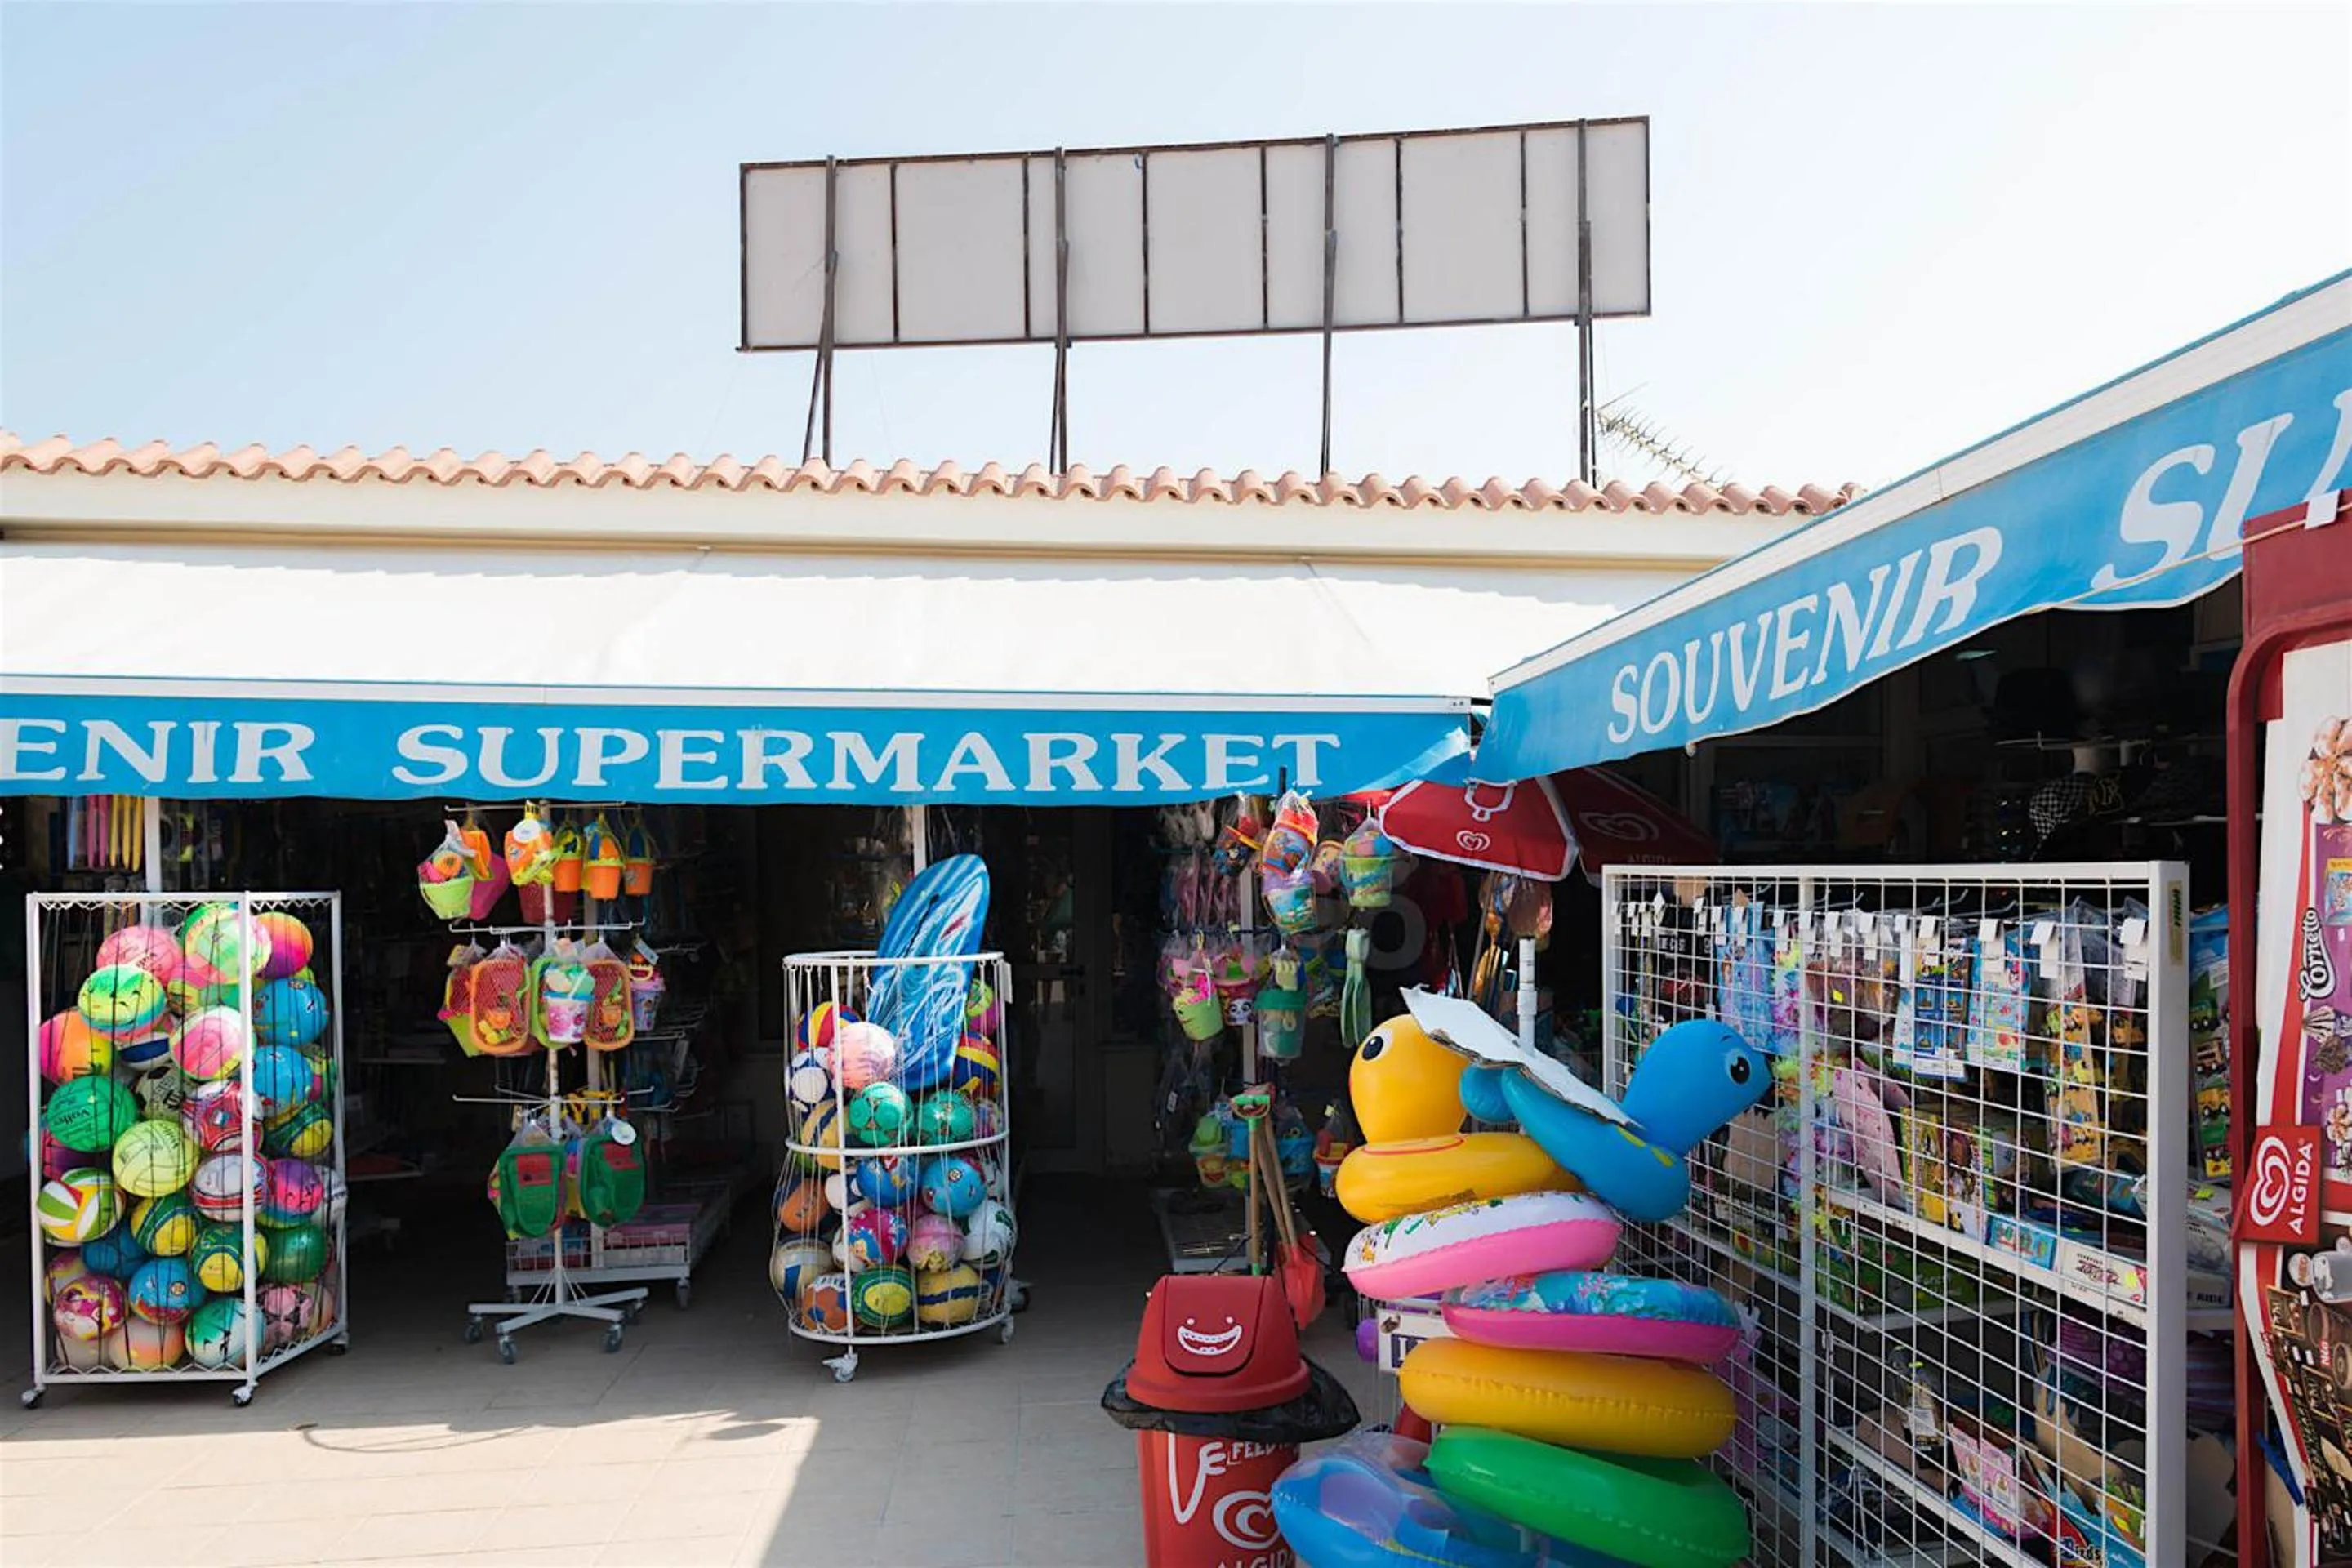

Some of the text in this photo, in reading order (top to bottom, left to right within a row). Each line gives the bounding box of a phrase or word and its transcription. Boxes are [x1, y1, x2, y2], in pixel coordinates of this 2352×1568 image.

[1606, 526, 2003, 745] SOUVENIR
[392, 724, 1341, 792] SUPERMARKET
[2298, 908, 2336, 1001] Cornetto
[2287, 1142, 2314, 1236] ALGIDA
